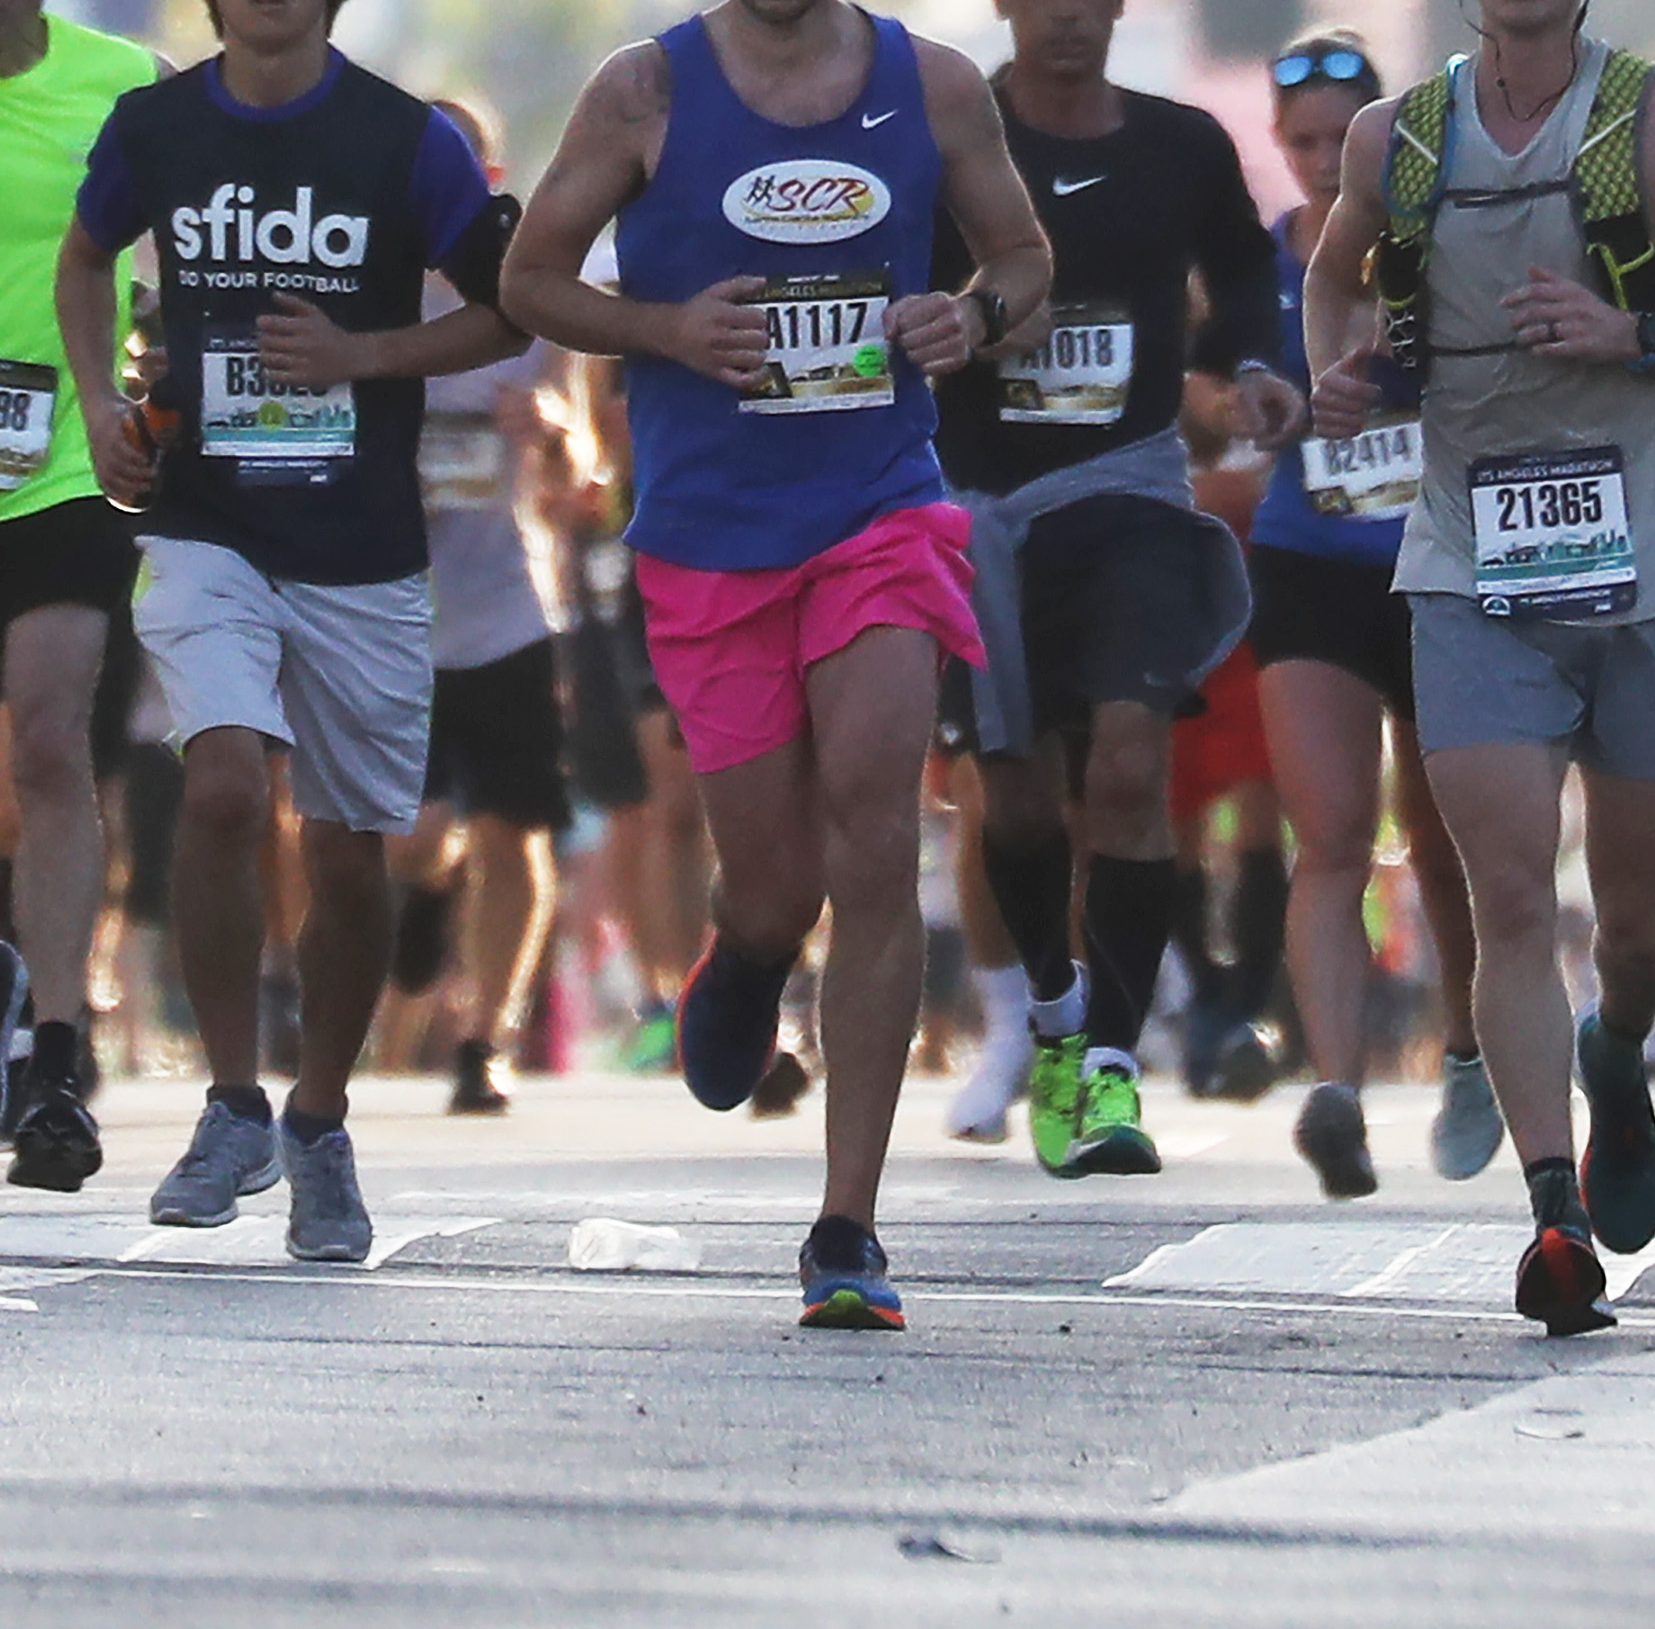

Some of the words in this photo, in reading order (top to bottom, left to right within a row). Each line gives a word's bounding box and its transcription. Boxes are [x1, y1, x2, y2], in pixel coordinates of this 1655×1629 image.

[172, 182, 369, 268] sfida
[203, 272, 258, 288] YOUR
[263, 272, 360, 293] FOOTBALL
[765, 301, 868, 350] A1117
[1496, 480, 1602, 532] 21365
